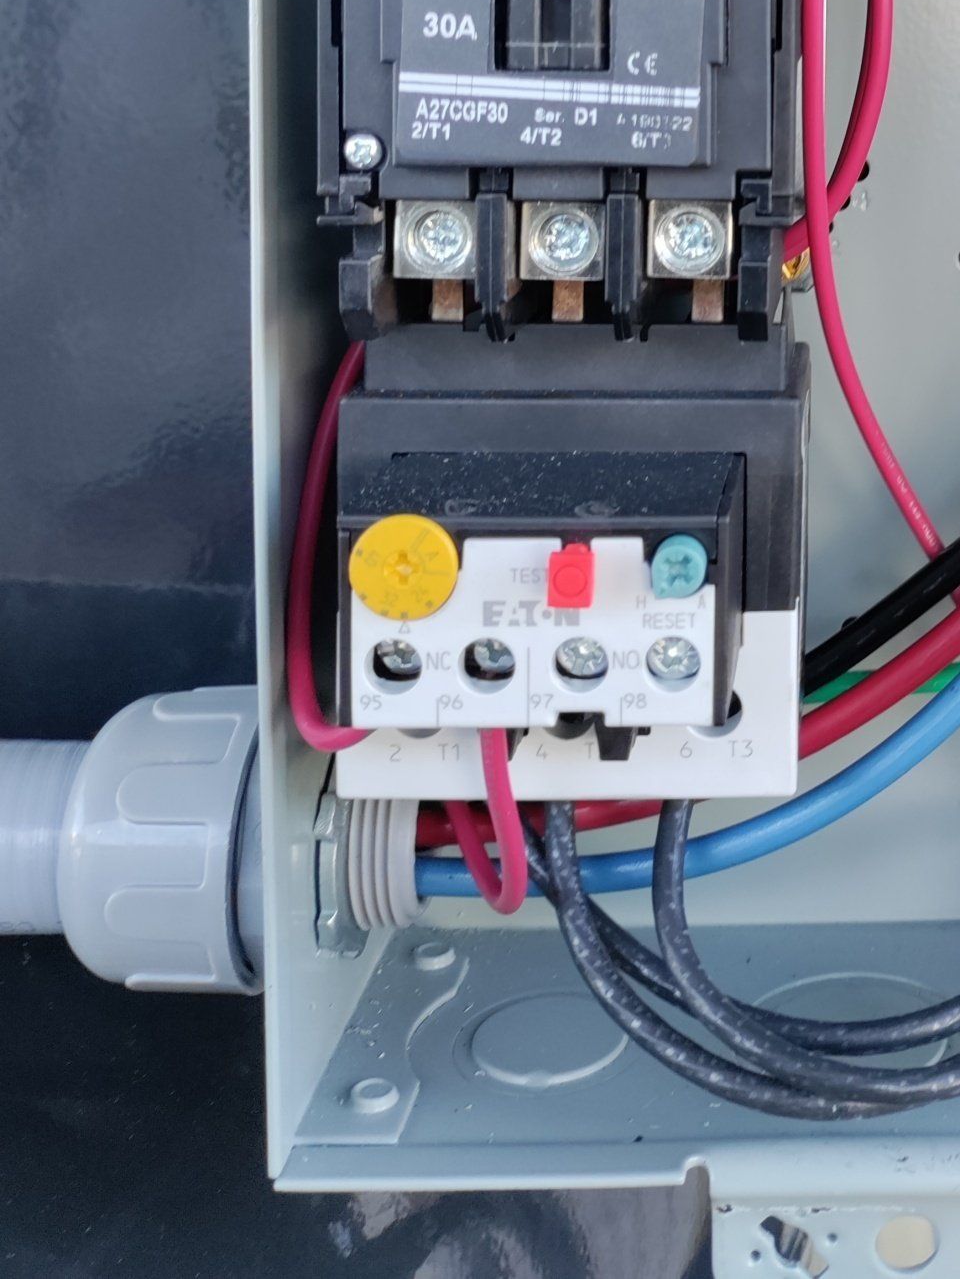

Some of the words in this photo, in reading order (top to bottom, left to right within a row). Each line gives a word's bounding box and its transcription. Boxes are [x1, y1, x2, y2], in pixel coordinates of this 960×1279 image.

[422, 11, 478, 41] 30A
[415, 97, 509, 124] A27CGF30
[574, 108, 598, 126] D1
[411, 122, 451, 141] 2/T1
[520, 126, 562, 146] 4/T2
[641, 612, 696, 629] RESET
[425, 650, 452, 671] NC
[612, 650, 641, 671] NO
[359, 695, 383, 711] 95
[440, 694, 464, 710] 96
[529, 693, 555, 710] 97
[623, 693, 648, 710] 98
[388, 744, 402, 762] 2
[438, 743, 461, 761] T1
[535, 743, 549, 760] 4
[679, 741, 693, 759] 6
[728, 740, 754, 758] T3
